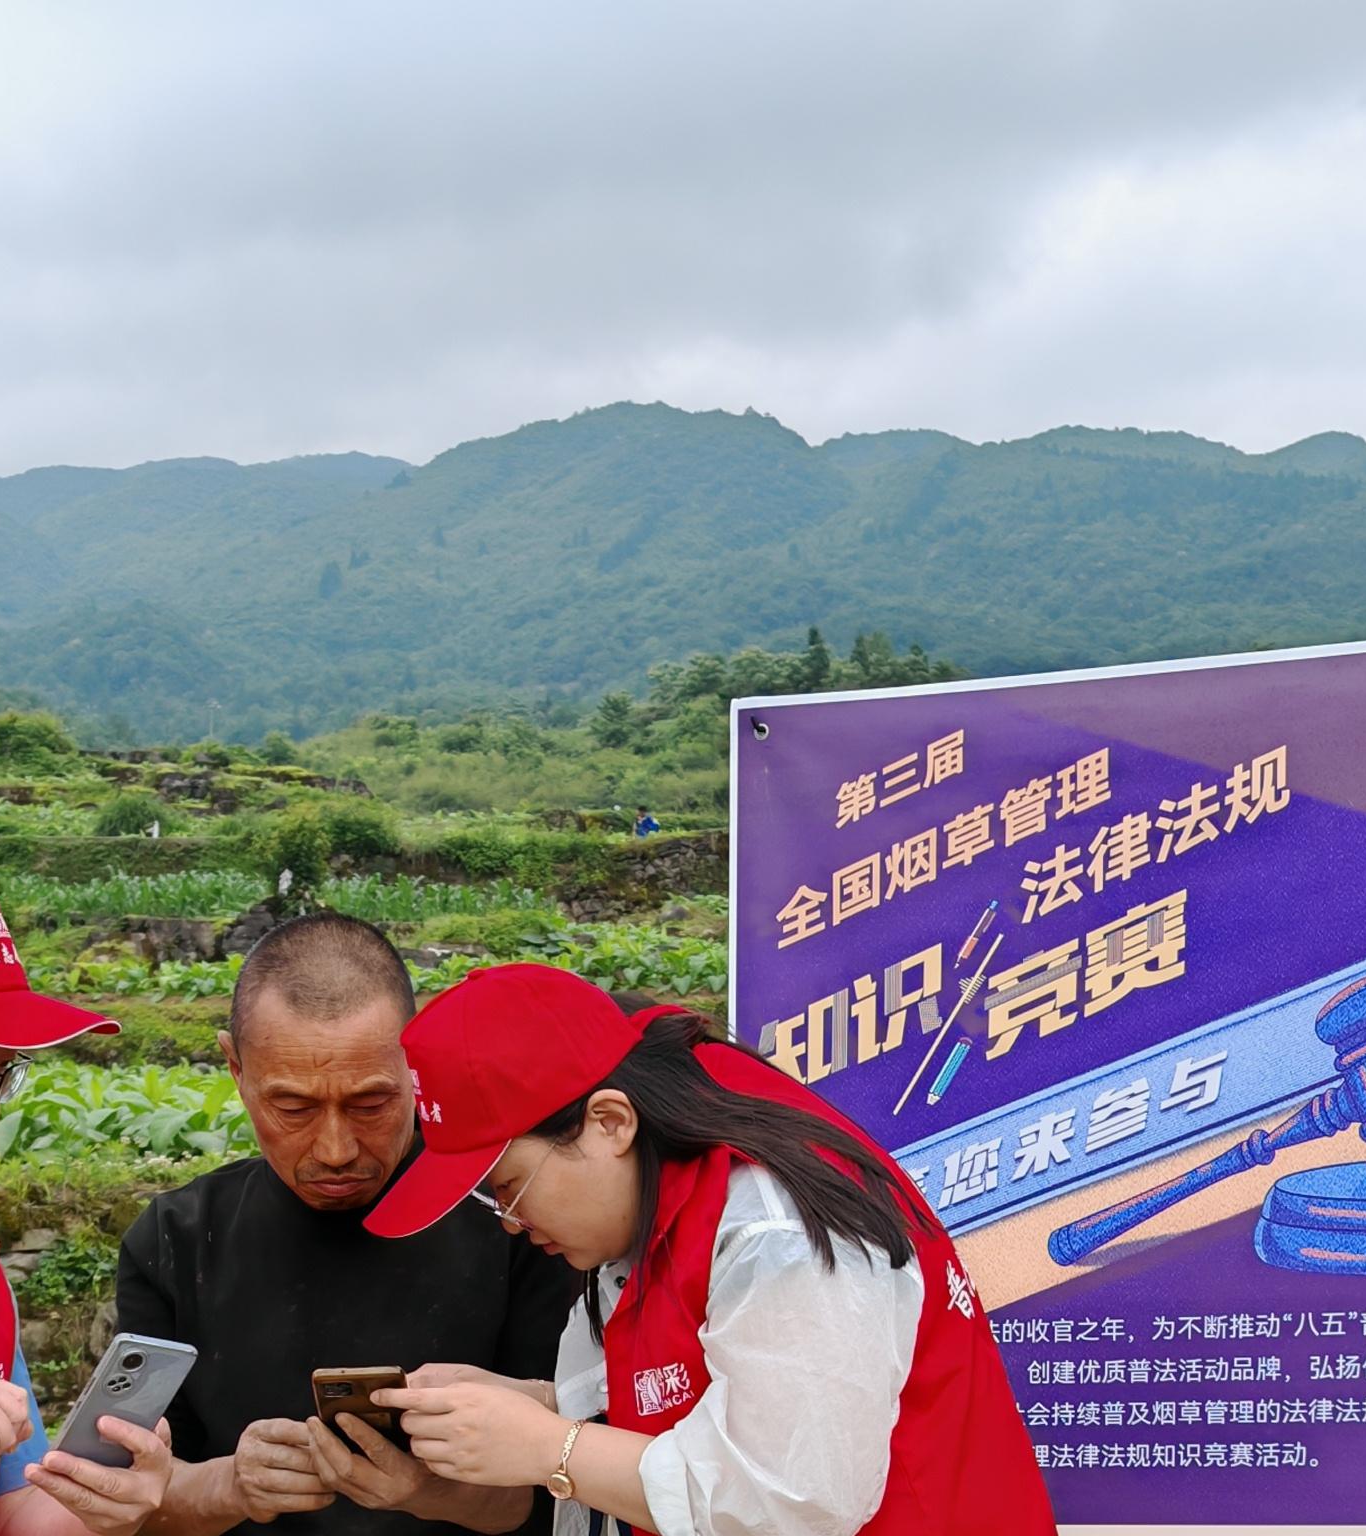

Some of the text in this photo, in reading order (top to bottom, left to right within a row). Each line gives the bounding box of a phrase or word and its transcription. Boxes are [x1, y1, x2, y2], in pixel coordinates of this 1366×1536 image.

[776, 747, 1111, 949] 全国烟草管理
[835, 728, 966, 829] 第三届
[1020, 744, 1292, 925] 法律法规
[984, 888, 1189, 1062] 竞赛
